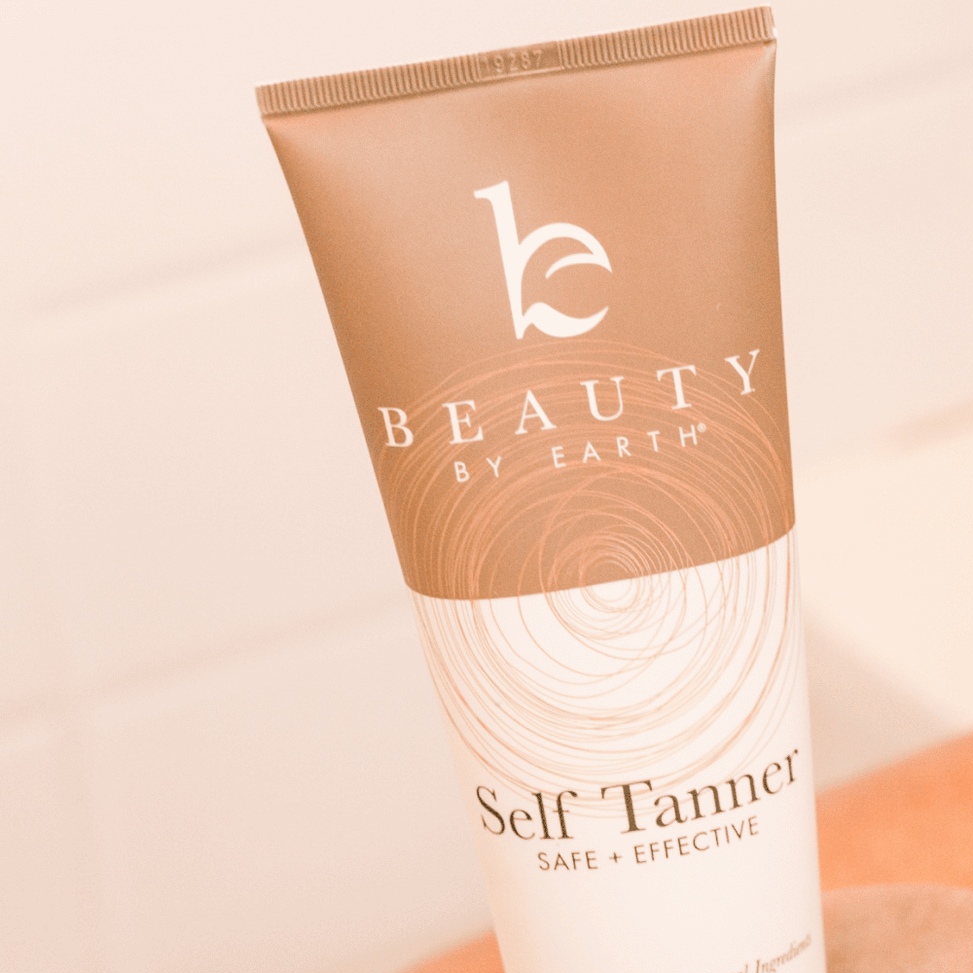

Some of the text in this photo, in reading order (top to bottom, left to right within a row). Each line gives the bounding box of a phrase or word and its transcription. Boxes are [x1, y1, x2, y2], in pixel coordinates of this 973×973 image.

[377, 349, 760, 448] BEAUTY
[454, 456, 502, 482] BY
[476, 748, 799, 841] Self Tanner
[537, 815, 760, 871] SAFE + EFFECTIVE
